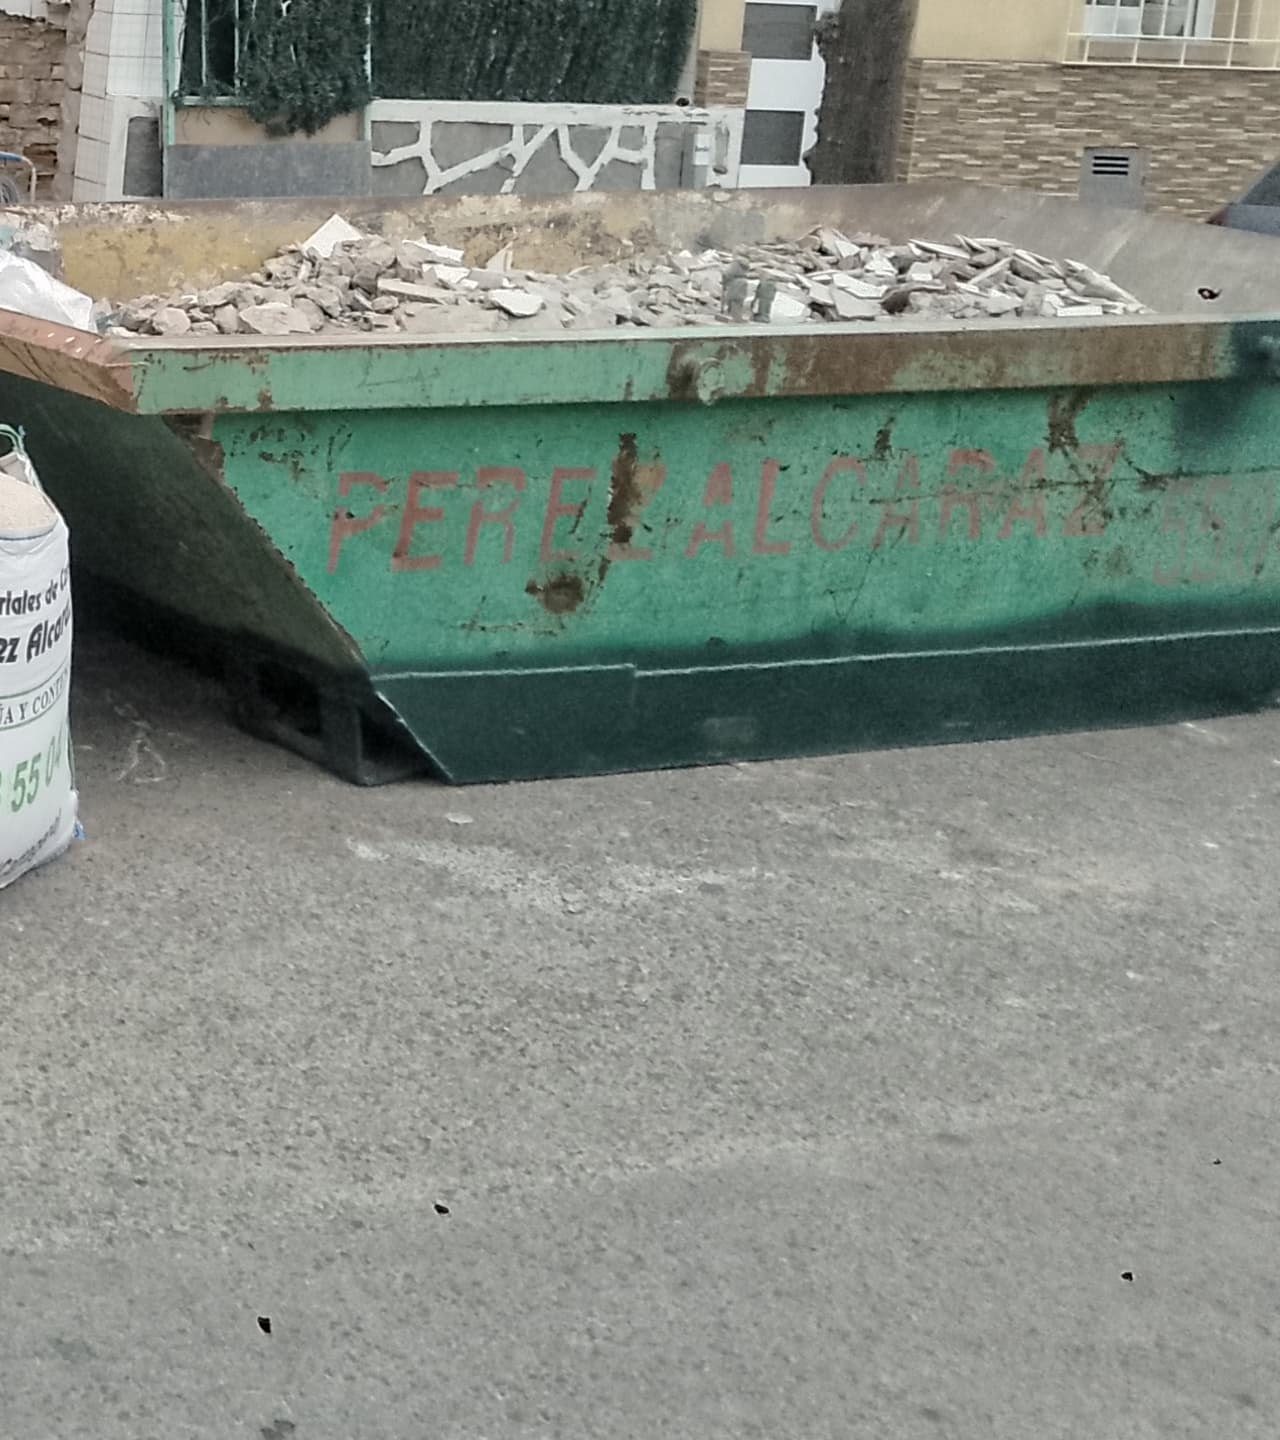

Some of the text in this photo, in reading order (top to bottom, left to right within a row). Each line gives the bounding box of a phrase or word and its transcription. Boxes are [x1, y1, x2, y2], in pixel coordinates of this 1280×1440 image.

[684, 444, 1127, 559] ALCARAZ
[19, 701, 28, 721] Y
[10, 751, 42, 813] 55
